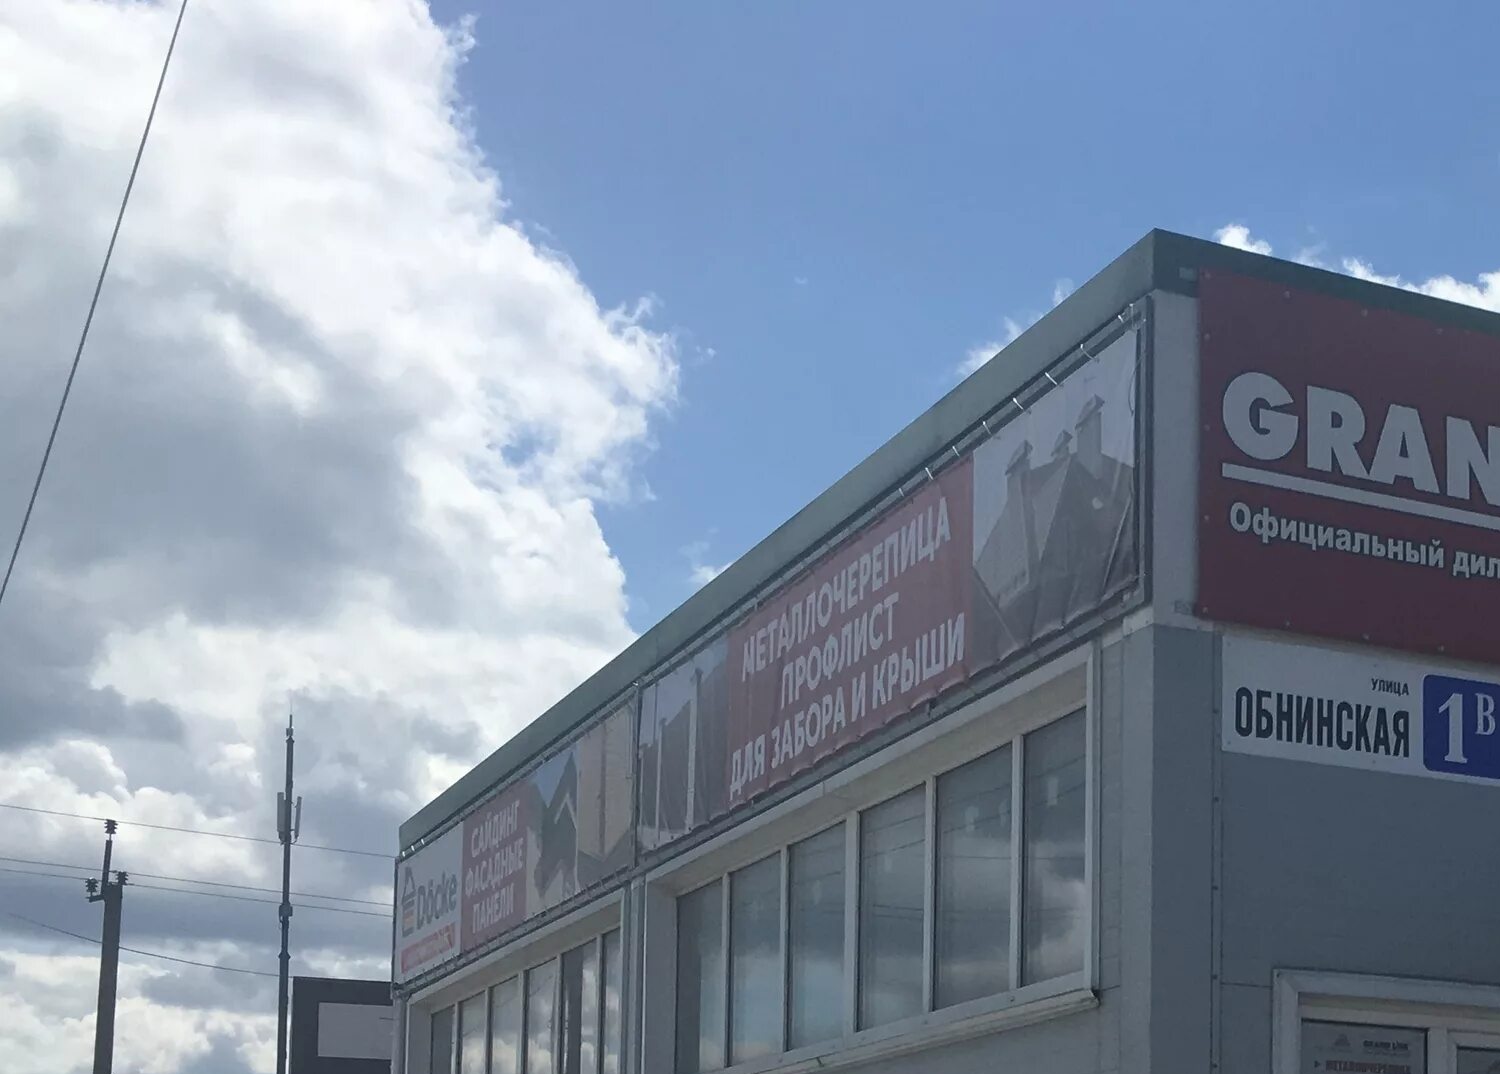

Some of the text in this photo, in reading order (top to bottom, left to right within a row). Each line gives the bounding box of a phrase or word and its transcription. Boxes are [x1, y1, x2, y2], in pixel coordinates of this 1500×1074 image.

[1229, 501, 1445, 568] Официальный
[742, 497, 951, 682] МЕТАЛЛОЧЕРЕПИЦА
[781, 592, 899, 710] ПРОФЛИСТ
[729, 612, 965, 801] ДЛЯ ЗАБОРА И КРЫШИ
[1370, 677, 1410, 696] УЛИЦА
[1234, 686, 1410, 758] ОБНИНСКАЯ
[471, 800, 521, 858] САЙДИНГ
[465, 837, 524, 898] ФАСАДНЫЕ
[472, 883, 515, 934] ПАНЕЛИ
